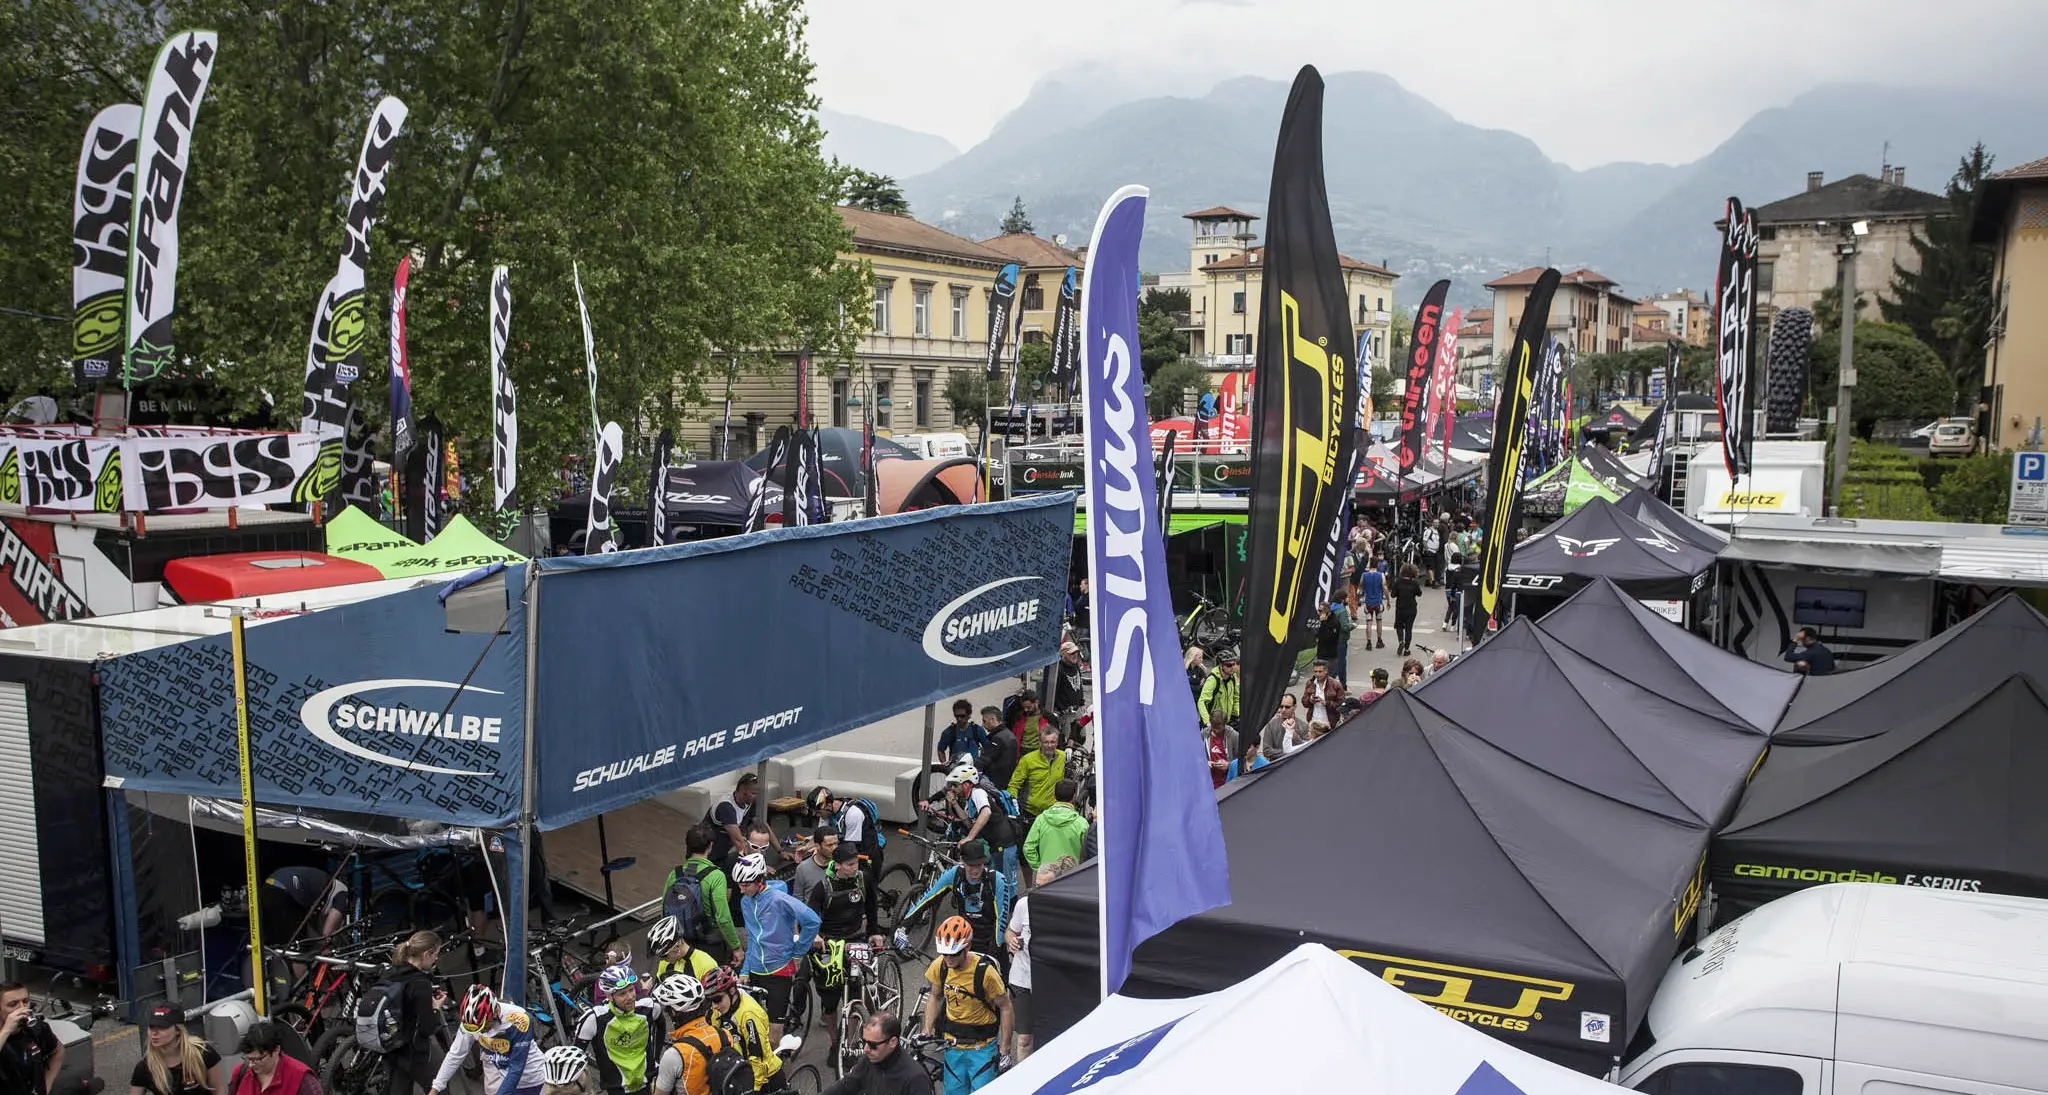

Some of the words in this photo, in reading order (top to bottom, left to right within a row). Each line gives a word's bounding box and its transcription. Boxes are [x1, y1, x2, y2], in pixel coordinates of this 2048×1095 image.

[987, 304, 1003, 371] bergamont
[1322, 353, 1344, 485] BICYCLES
[2024, 457, 2040, 478] P
[1725, 492, 1776, 506] Hertz
[829, 547, 858, 569] DIRTY
[797, 563, 818, 580] BIG
[819, 573, 852, 597] BETTY
[945, 598, 1040, 643] SCHWALBE
[157, 648, 204, 682] HANS
[272, 708, 302, 730] BIG
[175, 642, 269, 700] MARATON
[117, 706, 176, 745] DAMPF
[177, 737, 206, 760] BIG
[165, 686, 210, 716] PLUS
[268, 738, 331, 779] MUDDY
[335, 704, 502, 743] SCHWALBE
[153, 741, 196, 771] FRED
[196, 732, 239, 763] PLUS
[277, 726, 360, 778] ULTREMO
[573, 743, 677, 793] SCHWALBE
[682, 729, 727, 759] RACE
[732, 706, 803, 744] SUPPORT
[1734, 863, 1898, 884] cannondale
[1904, 873, 1983, 893] E-SERIES
[848, 949, 869, 960] 265
